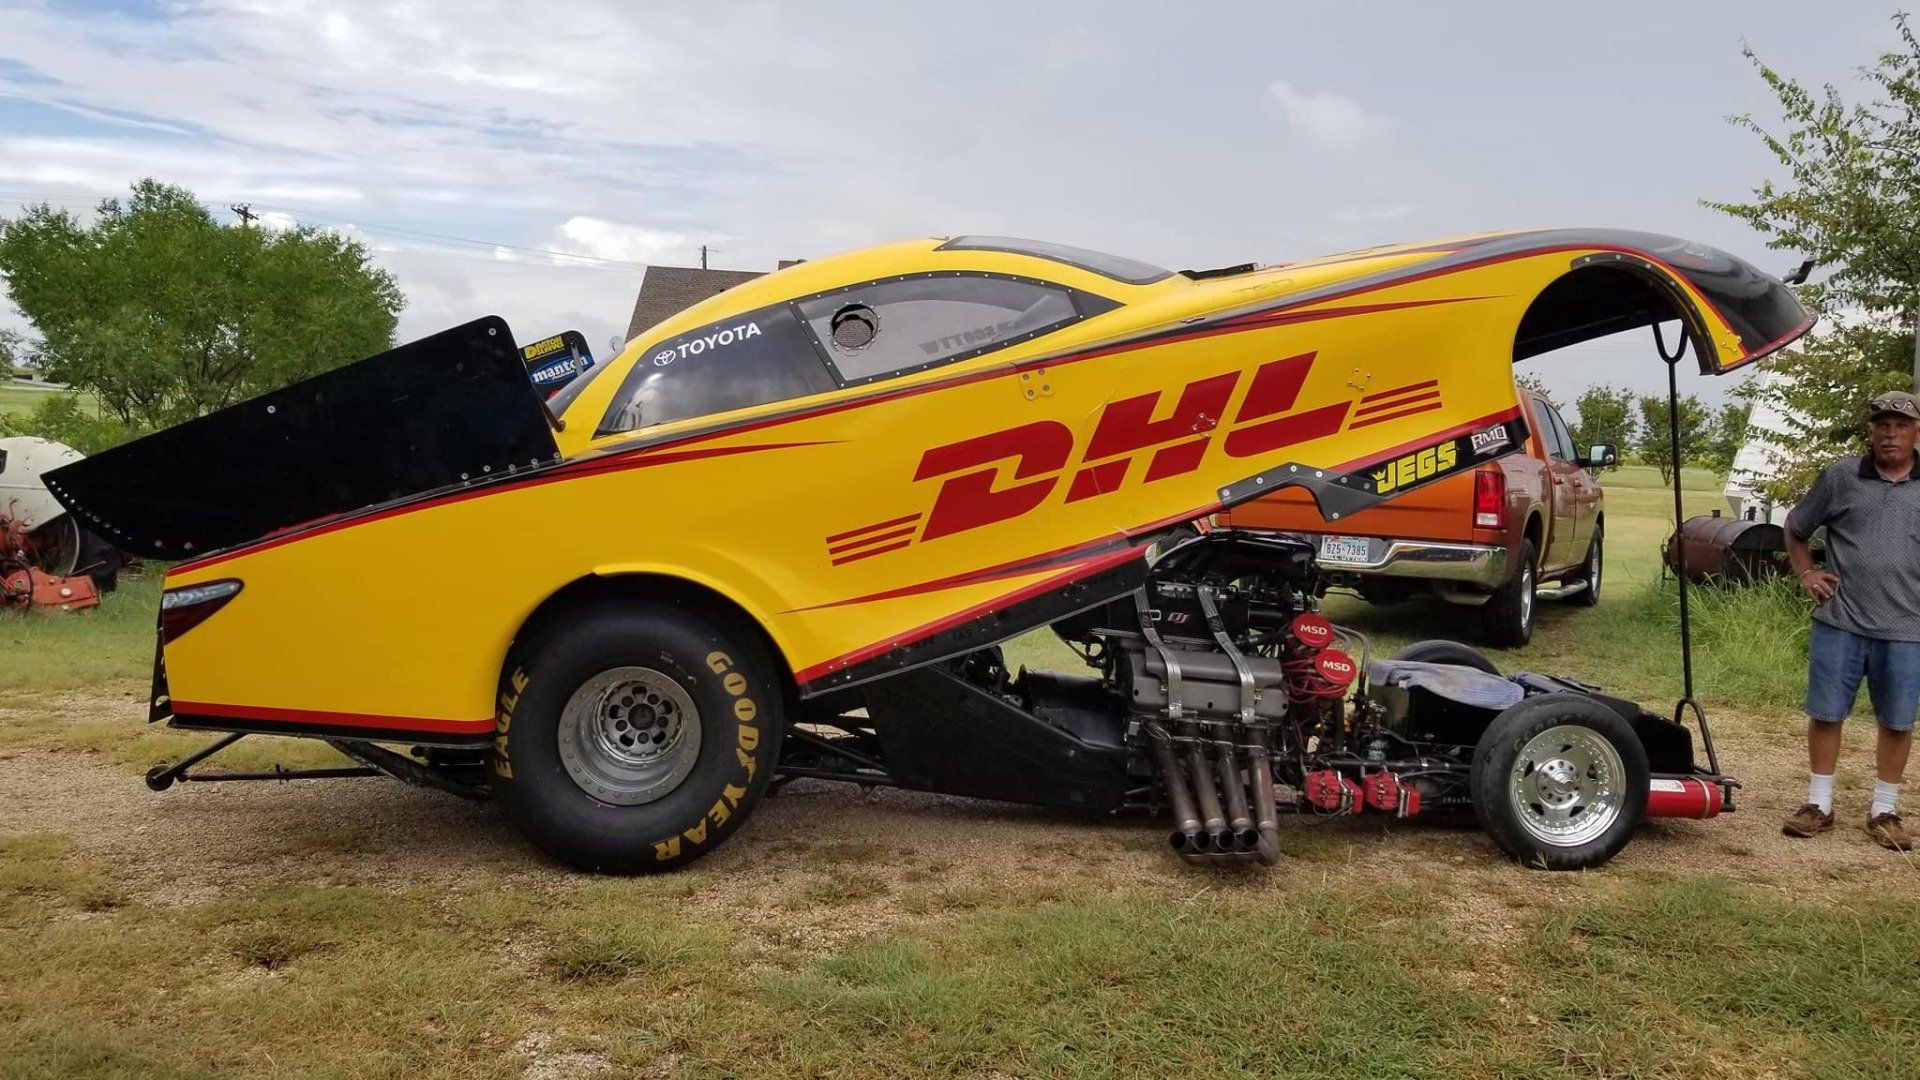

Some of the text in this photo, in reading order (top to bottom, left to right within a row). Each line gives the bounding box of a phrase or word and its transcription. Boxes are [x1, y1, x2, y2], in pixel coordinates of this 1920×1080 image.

[677, 322, 762, 359] TOYOTA
[913, 350, 1352, 543] DHL
[1377, 440, 1457, 495] JEGS
[1300, 624, 1328, 636] MSD
[1322, 660, 1351, 672] MSD
[495, 666, 530, 780] EAGLE
